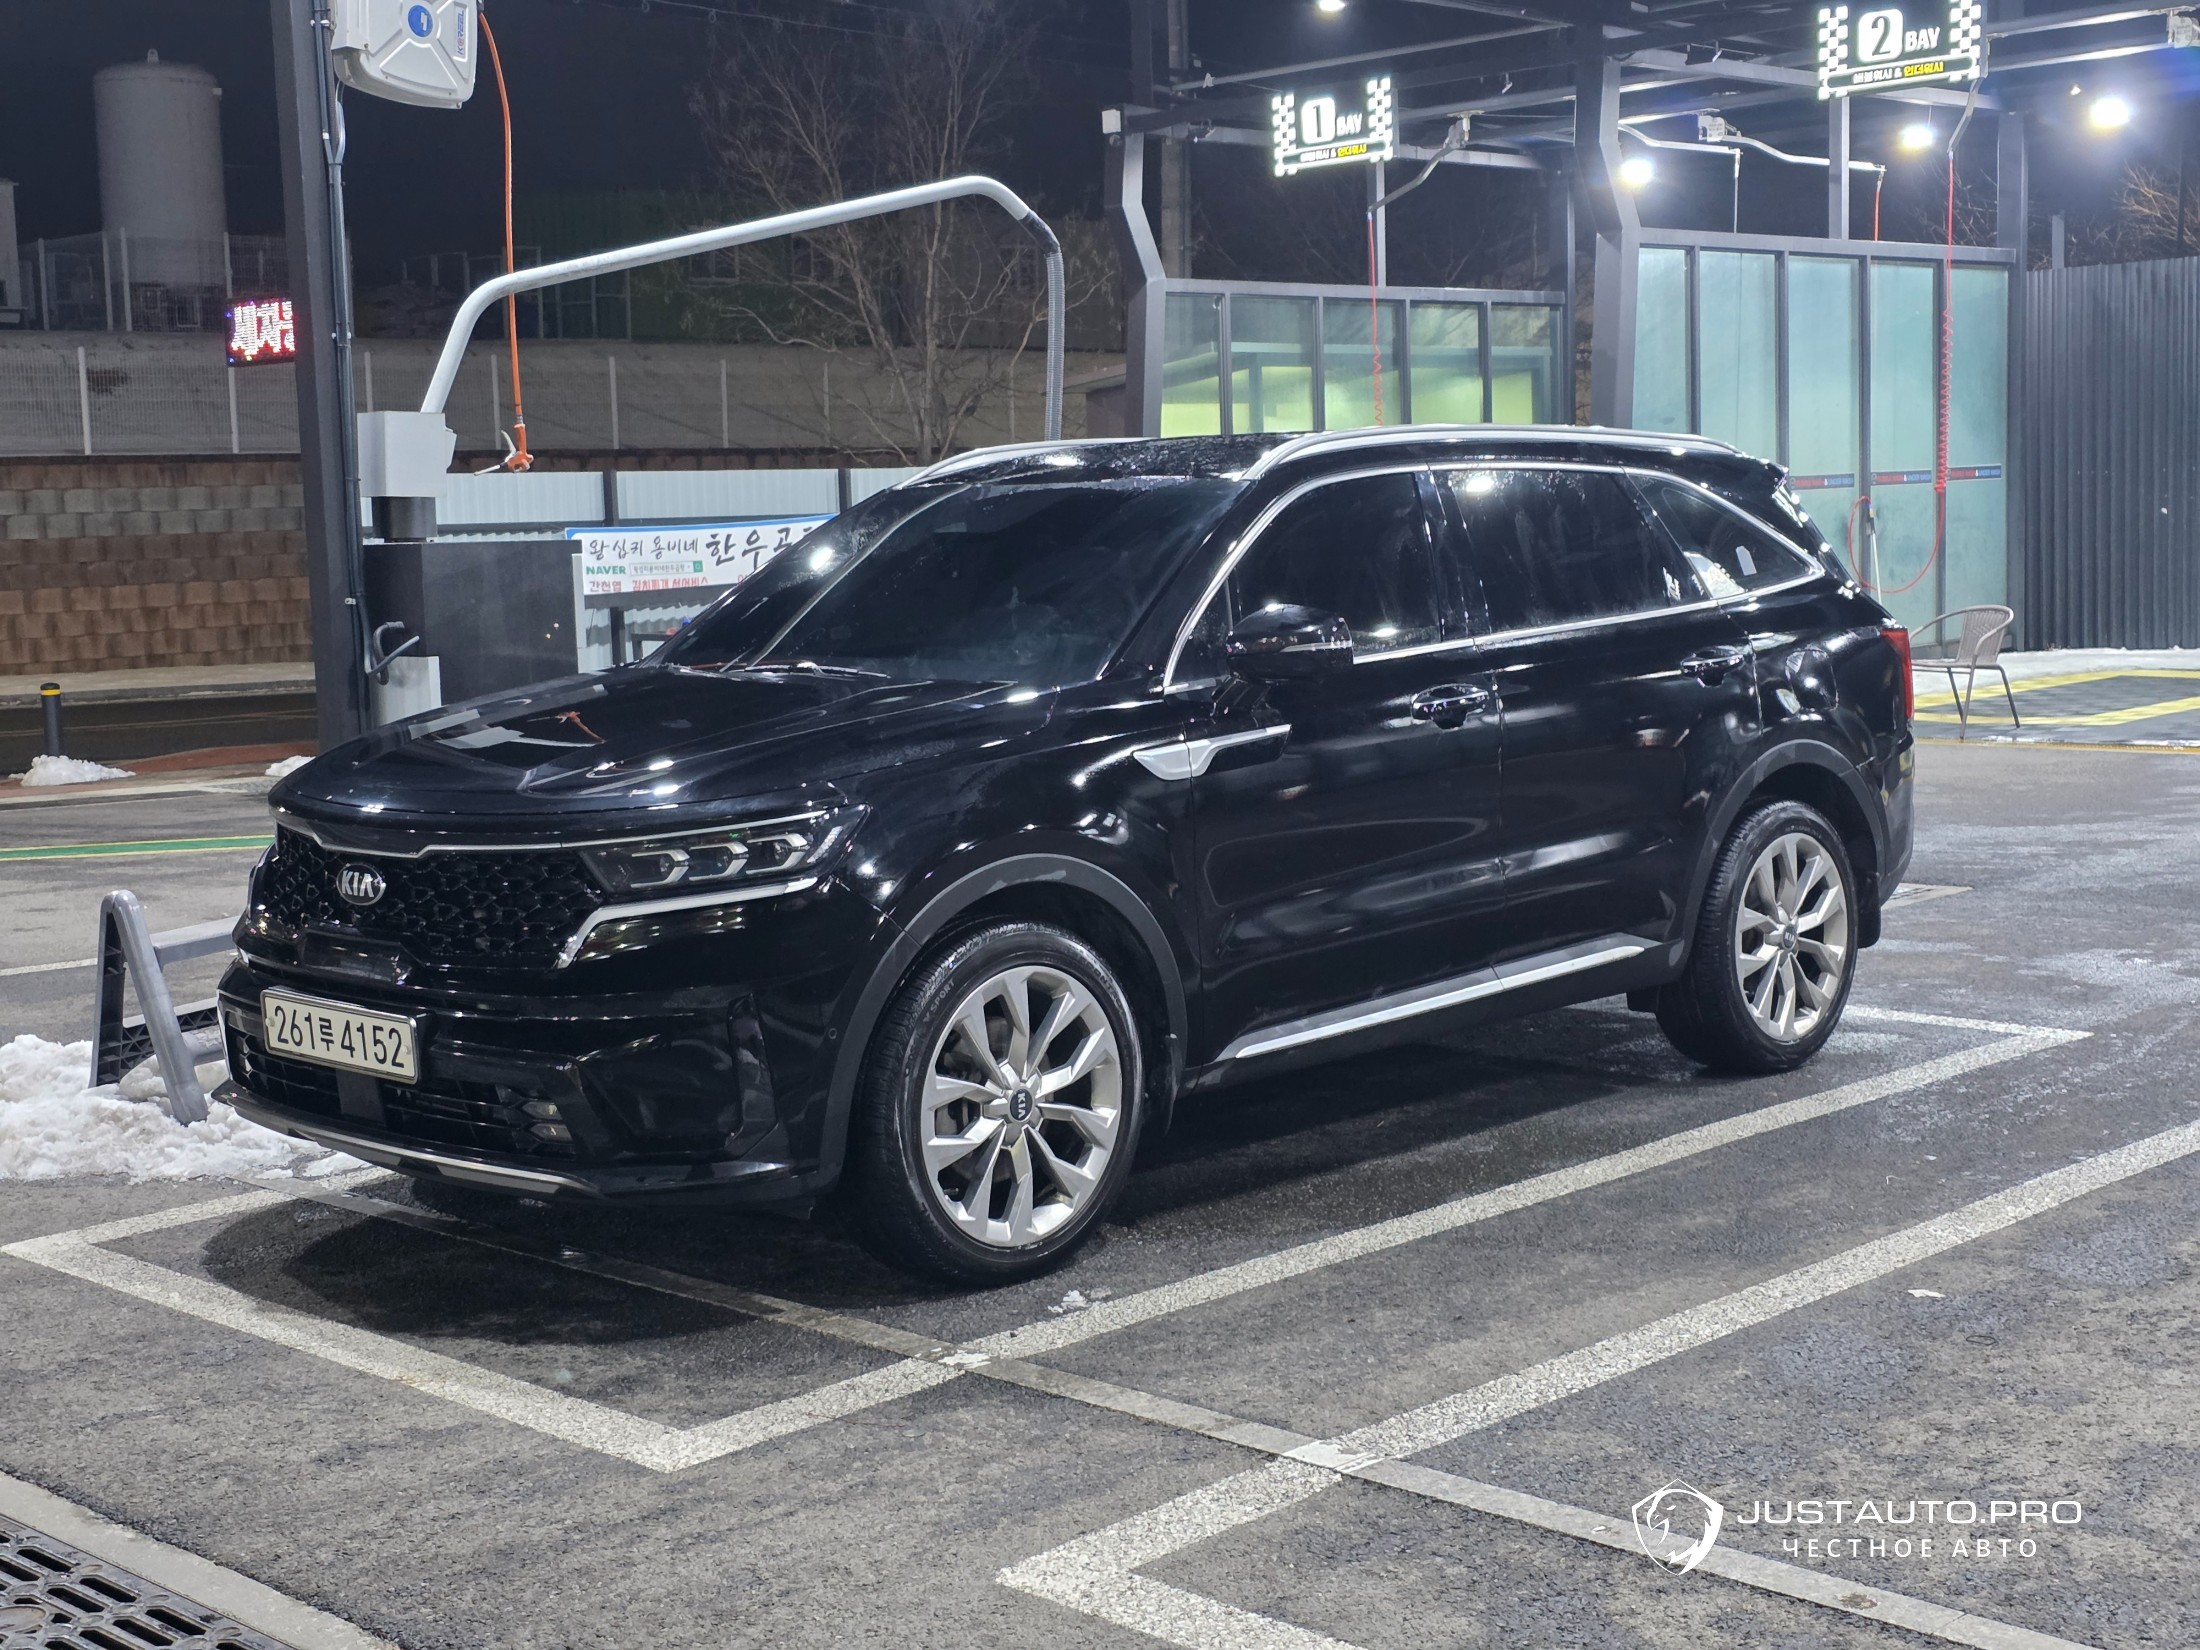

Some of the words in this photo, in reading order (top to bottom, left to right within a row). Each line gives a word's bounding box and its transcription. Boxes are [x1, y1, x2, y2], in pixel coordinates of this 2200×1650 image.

[1904, 27, 1940, 52] BAY
[1336, 113, 1362, 136] BAY
[585, 565, 626, 575] NAVER
[341, 869, 375, 898] KIA
[930, 978, 954, 1013] SPORT
[274, 1005, 405, 1068] 261루4152
[1017, 1092, 1026, 1119] KIA
